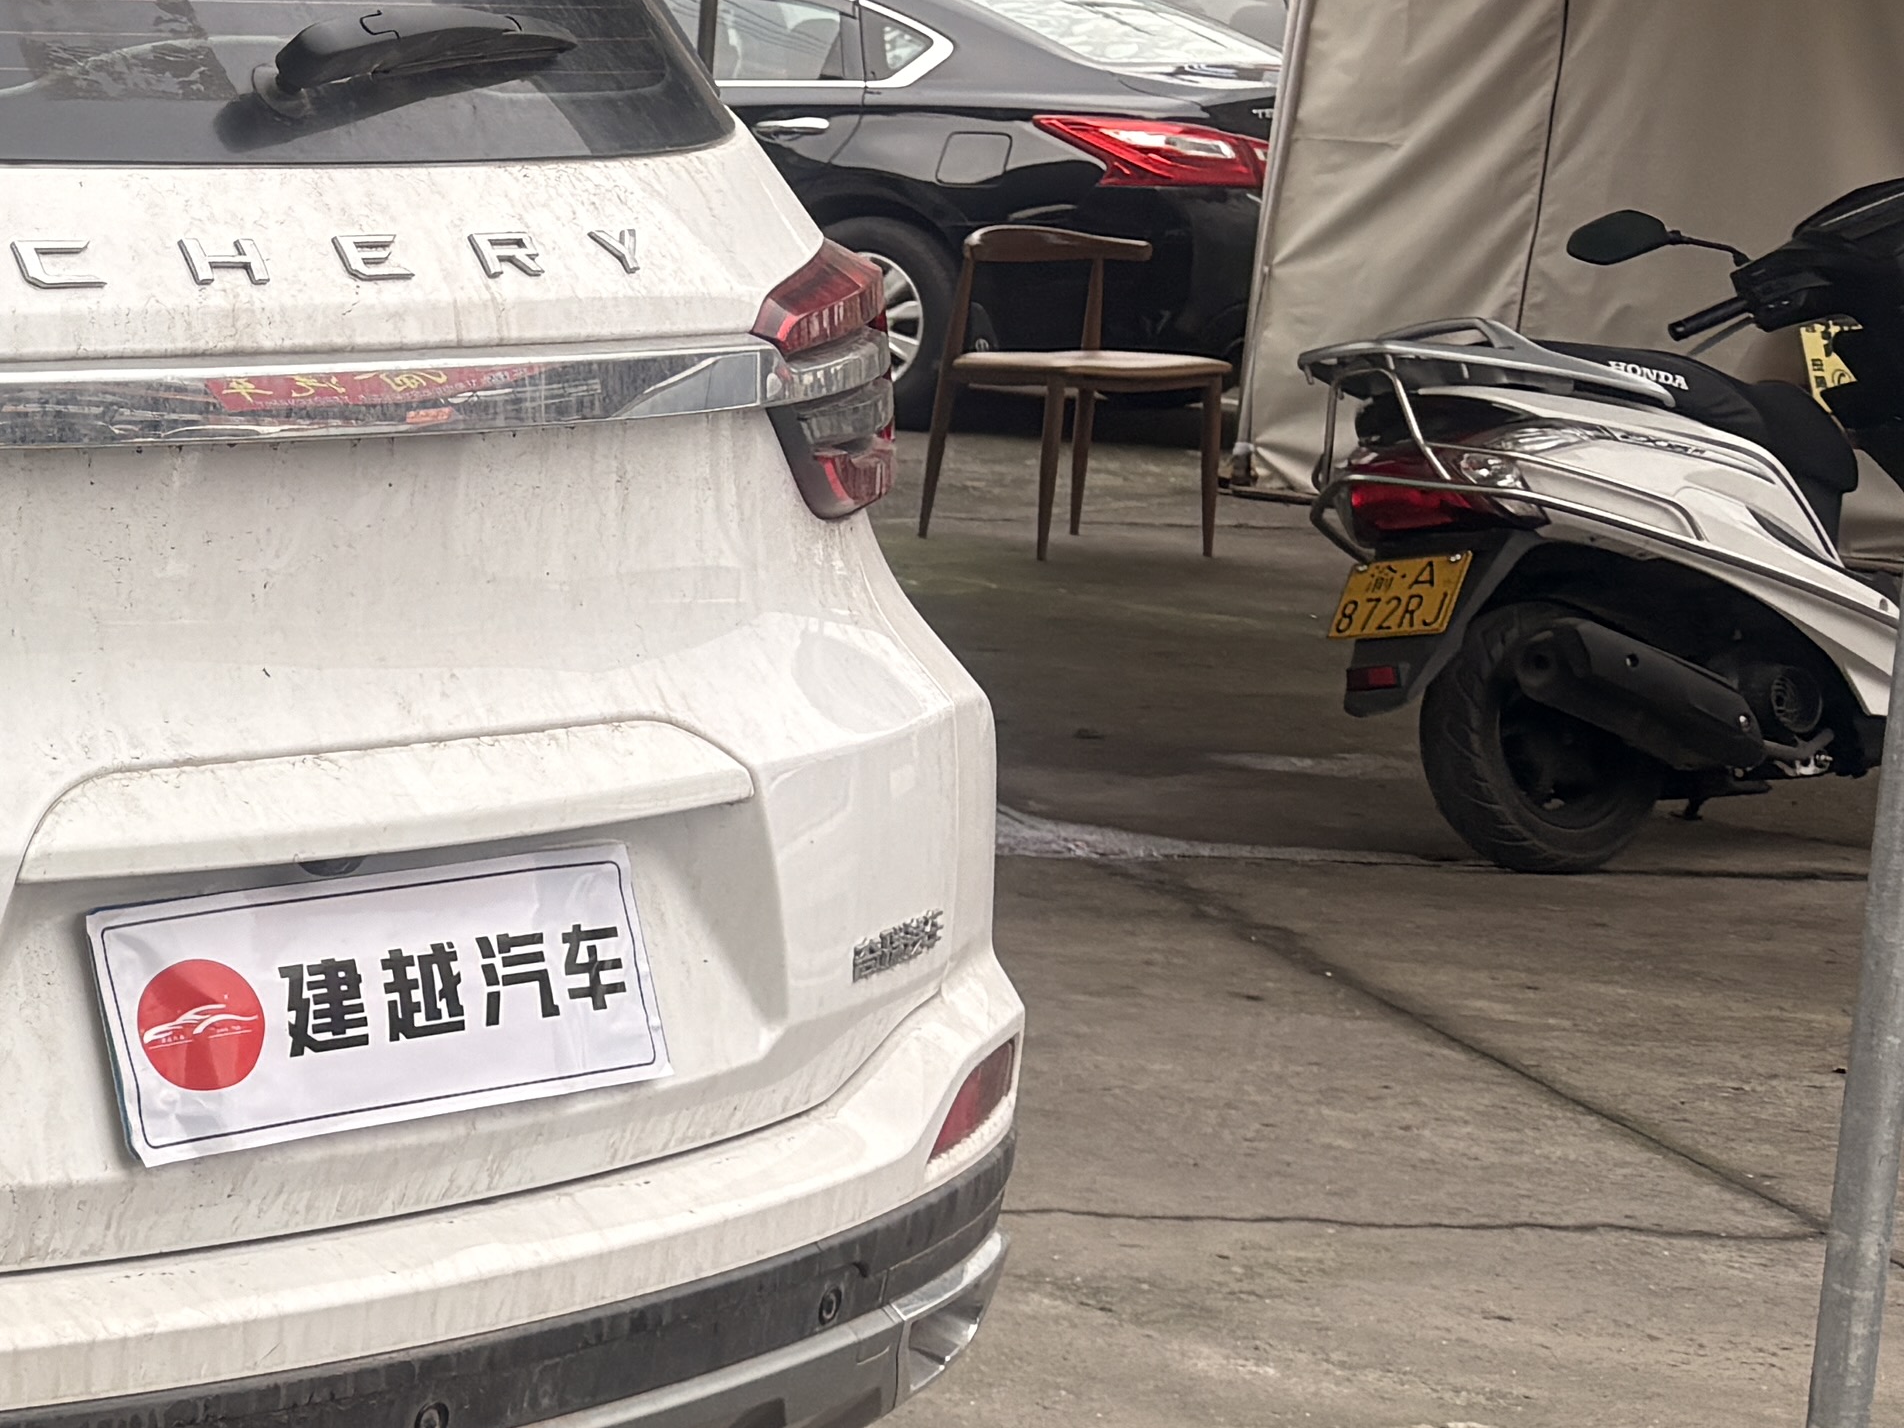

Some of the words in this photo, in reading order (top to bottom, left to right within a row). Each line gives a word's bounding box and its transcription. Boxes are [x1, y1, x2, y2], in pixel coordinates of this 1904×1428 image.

[9, 225, 641, 290] CHERY
[1607, 360, 1690, 392] HONDA
[1335, 591, 1449, 634] 872RJ
[276, 923, 628, 1058] 建越汽车
